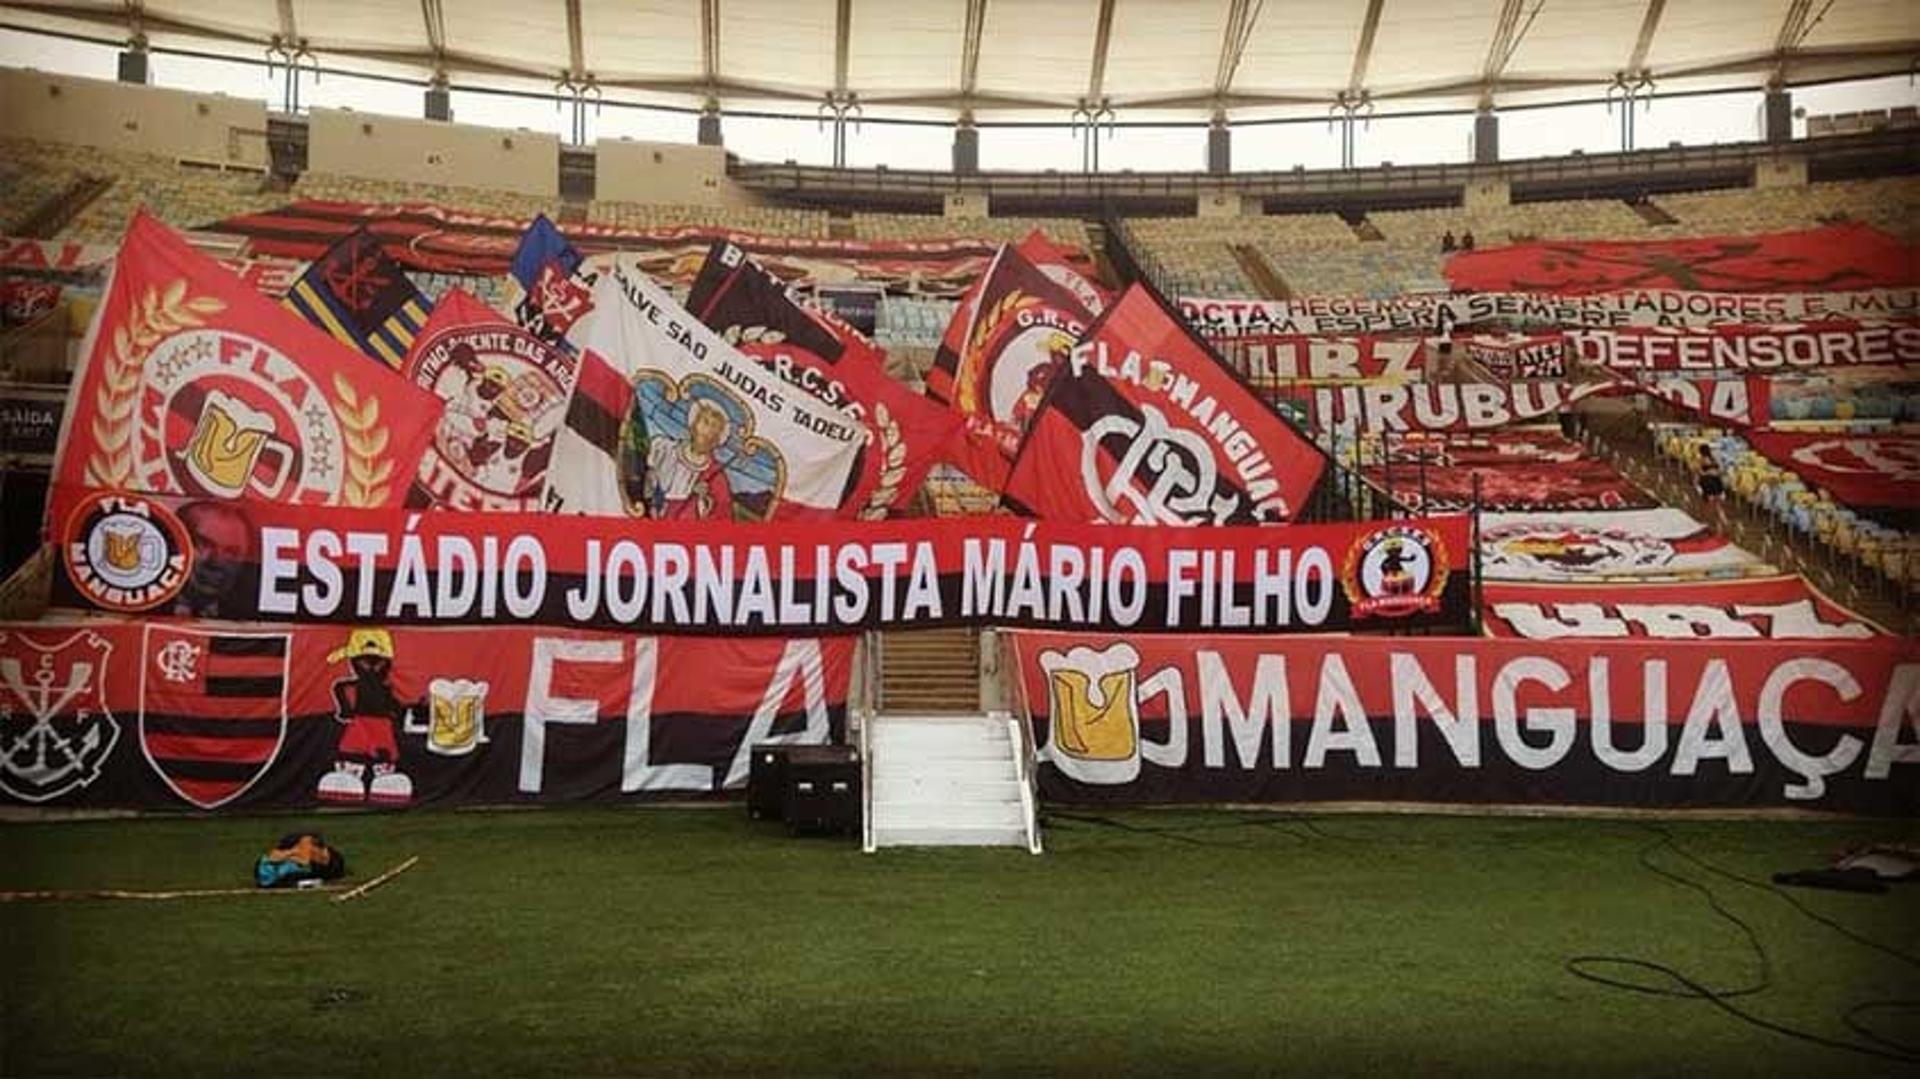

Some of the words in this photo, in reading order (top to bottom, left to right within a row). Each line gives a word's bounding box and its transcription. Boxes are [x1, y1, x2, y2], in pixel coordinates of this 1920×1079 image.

[1469, 296, 1634, 329] SEMPRE
[219, 335, 310, 412] FLA
[514, 336, 545, 365] DAS
[1577, 327, 1920, 369] DEFENSORES
[713, 361, 785, 413] JUDAS
[793, 405, 857, 442] TADEU
[99, 496, 151, 519] FLA
[258, 514, 547, 619] ESTÁDIO
[566, 539, 943, 625] JORNALISTA
[960, 523, 1147, 627] MÁRIO
[1166, 546, 1334, 627] FILHO
[518, 636, 833, 793] FLA
[1196, 650, 1920, 800] MANGUAÇA
